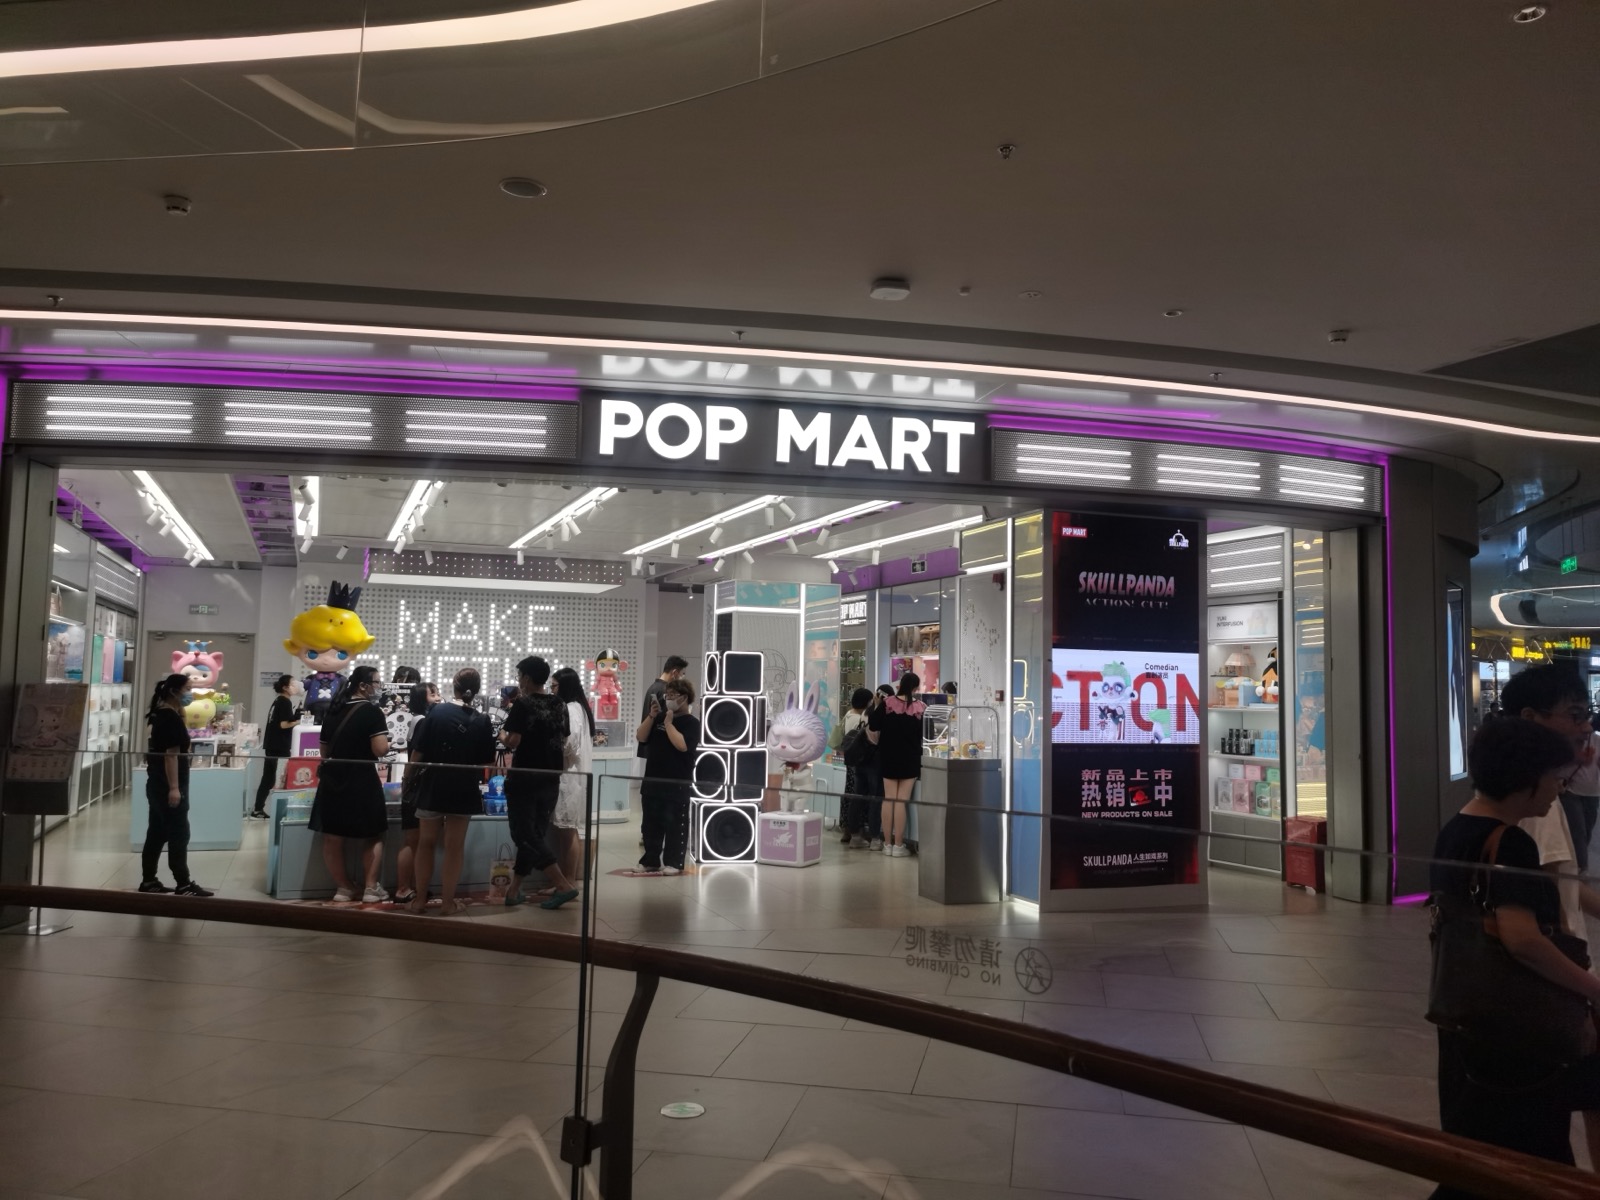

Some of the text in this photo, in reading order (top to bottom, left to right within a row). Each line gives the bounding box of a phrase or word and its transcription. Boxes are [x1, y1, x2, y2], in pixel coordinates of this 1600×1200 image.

[599, 399, 976, 473] POP MART
[1062, 527, 1087, 537] POP MART
[1078, 571, 1175, 598] SKULLPANDA
[1085, 598, 1134, 608] ACTION!
[399, 599, 556, 652] MAKE
[1144, 662, 1179, 671] Comedian
[1081, 769, 1172, 781] 新品上市
[1081, 810, 1173, 819] NEW PRODUCTS ON SALE
[1083, 853, 1133, 867] SKULLPANDA
